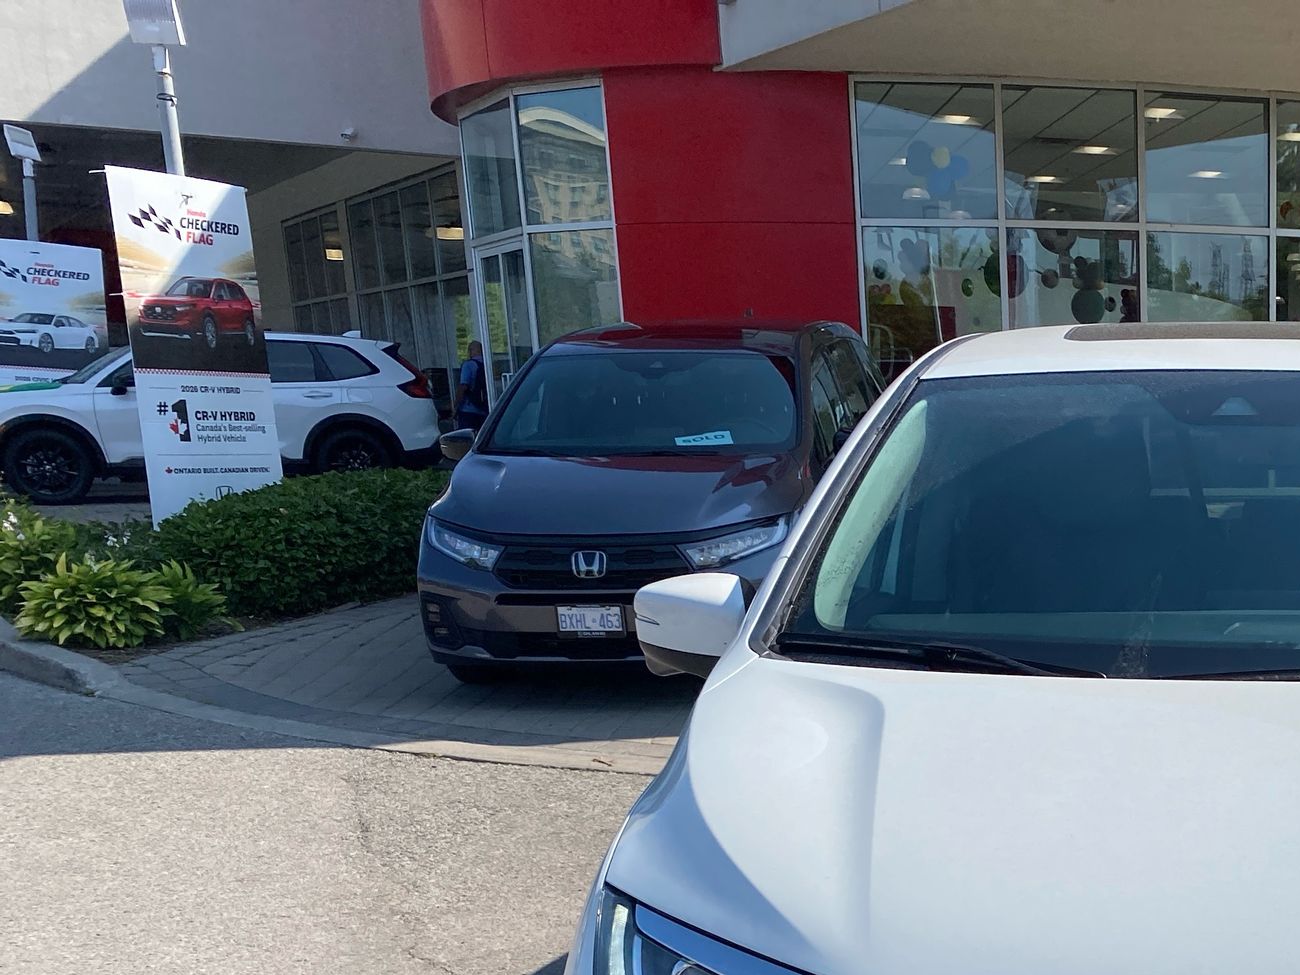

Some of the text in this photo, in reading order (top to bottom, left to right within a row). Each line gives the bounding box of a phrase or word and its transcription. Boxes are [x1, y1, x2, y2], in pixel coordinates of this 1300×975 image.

[180, 217, 240, 236] CHECKERED
[186, 232, 214, 246] FLAG
[26, 267, 90, 281] CHECKERED
[32, 276, 60, 287] FLAG
[180, 385, 199, 393] 2026
[200, 386, 215, 394] CR-V
[195, 410, 256, 422] CR-V HYBRID
[196, 423, 267, 434] Canada's Best-selling
[197, 434, 247, 444] Hybrid Vehicle
[173, 467, 202, 475] ONTARIO
[559, 613, 621, 629] BXHL 463
